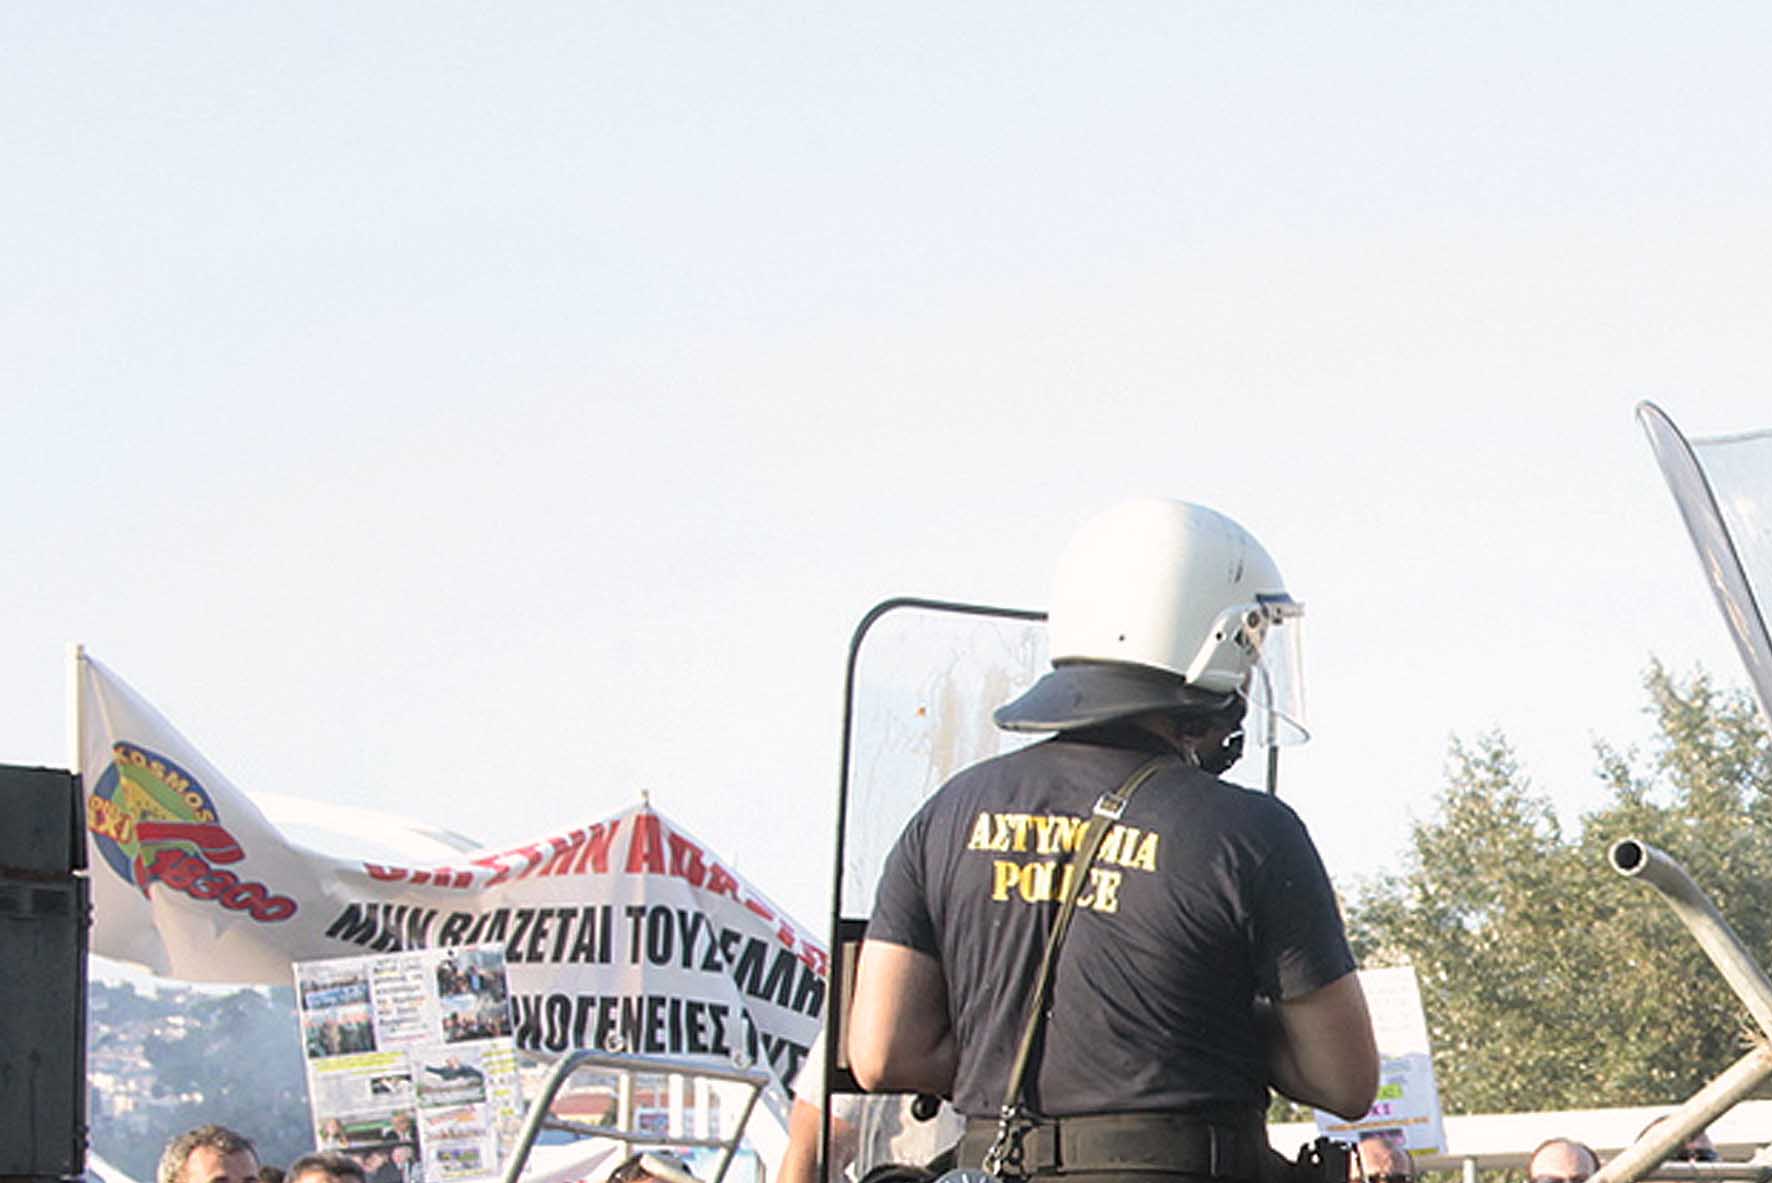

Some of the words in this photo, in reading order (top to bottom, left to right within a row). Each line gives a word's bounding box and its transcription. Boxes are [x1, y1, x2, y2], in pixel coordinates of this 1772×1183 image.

[325, 902, 438, 952] ΜΗΝ
[439, 904, 612, 964] ΒΙΑΖΕΤΑΙ
[625, 904, 724, 972] ΤΟΥΣ
